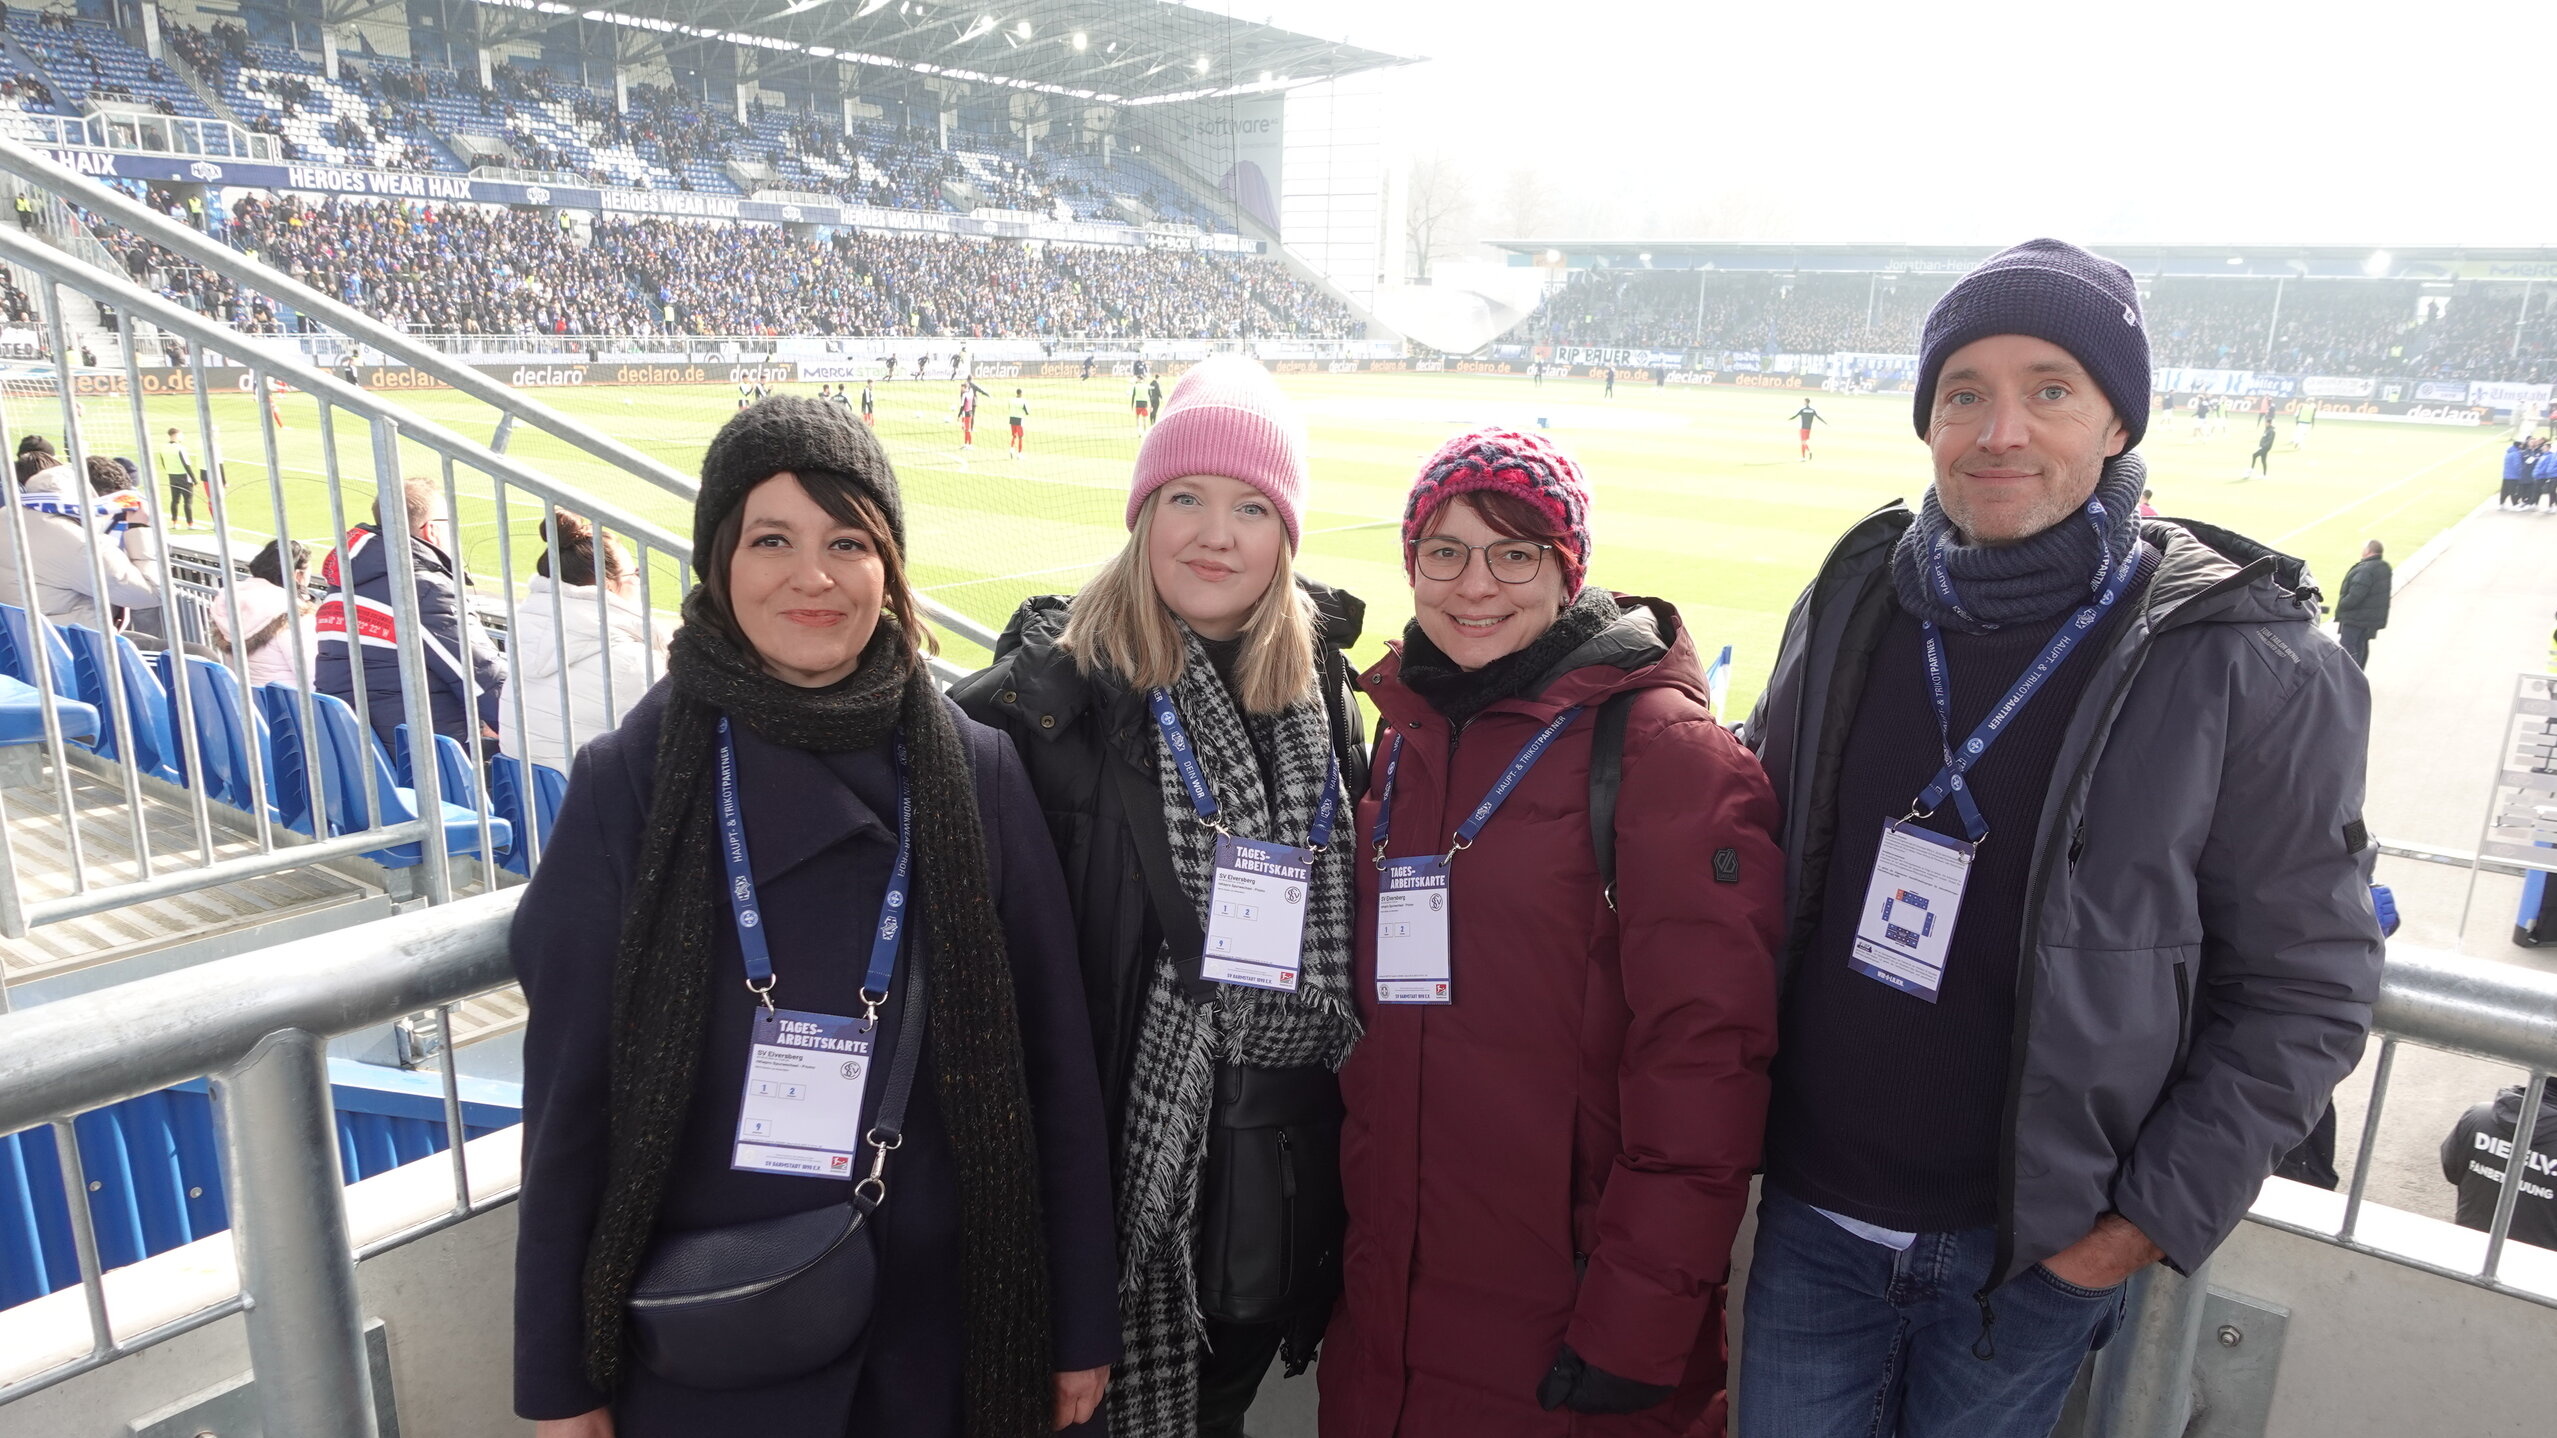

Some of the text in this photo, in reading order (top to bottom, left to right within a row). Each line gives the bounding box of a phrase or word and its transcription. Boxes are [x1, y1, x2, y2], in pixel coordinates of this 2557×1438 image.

[59, 151, 117, 175] HAIX
[289, 167, 472, 199] HEROES WEAR HAIX
[601, 191, 740, 217] HEROES WEAR HAIX
[1559, 348, 1631, 364] RIP BAUER
[617, 365, 705, 383] declaro.de
[975, 362, 1020, 377] declaro
[1328, 360, 1358, 373] declaro
[1457, 360, 1511, 373] declaro.de
[1589, 367, 1648, 380] decaro.de
[513, 366, 584, 385] declaro
[1665, 370, 1712, 385] declaro
[1736, 373, 1802, 388] declaro.de
[2408, 405, 2480, 421] declaro
[1926, 637, 1944, 697] TRIKOTPARTNER
[2037, 663, 2047, 671] &
[1988, 671, 2042, 730] TRIKOTPARTNER
[1495, 715, 1566, 795] HAUPT- & TRIKOTPARTNER
[720, 746, 736, 818] TRIKOTPARTNER
[1183, 760, 1197, 779] DEIN
[1191, 779, 1205, 798] WOR
[897, 797, 912, 878] WORKWEAR-PROFI
[1236, 846, 1271, 861] TAGES-
[1234, 858, 1307, 879] ARBEITSKARTE
[1390, 866, 1416, 878] TAGES-
[1227, 875, 1255, 885] Elversberg
[1390, 875, 1445, 889] ARBEITSKARTE
[779, 1020, 824, 1034] TAGES-
[777, 1033, 869, 1054] ARBEITSKARTE
[768, 1051, 803, 1061] Elversberg
[789, 1087, 796, 1095] 2
[2474, 1131, 2513, 1160] DIE
